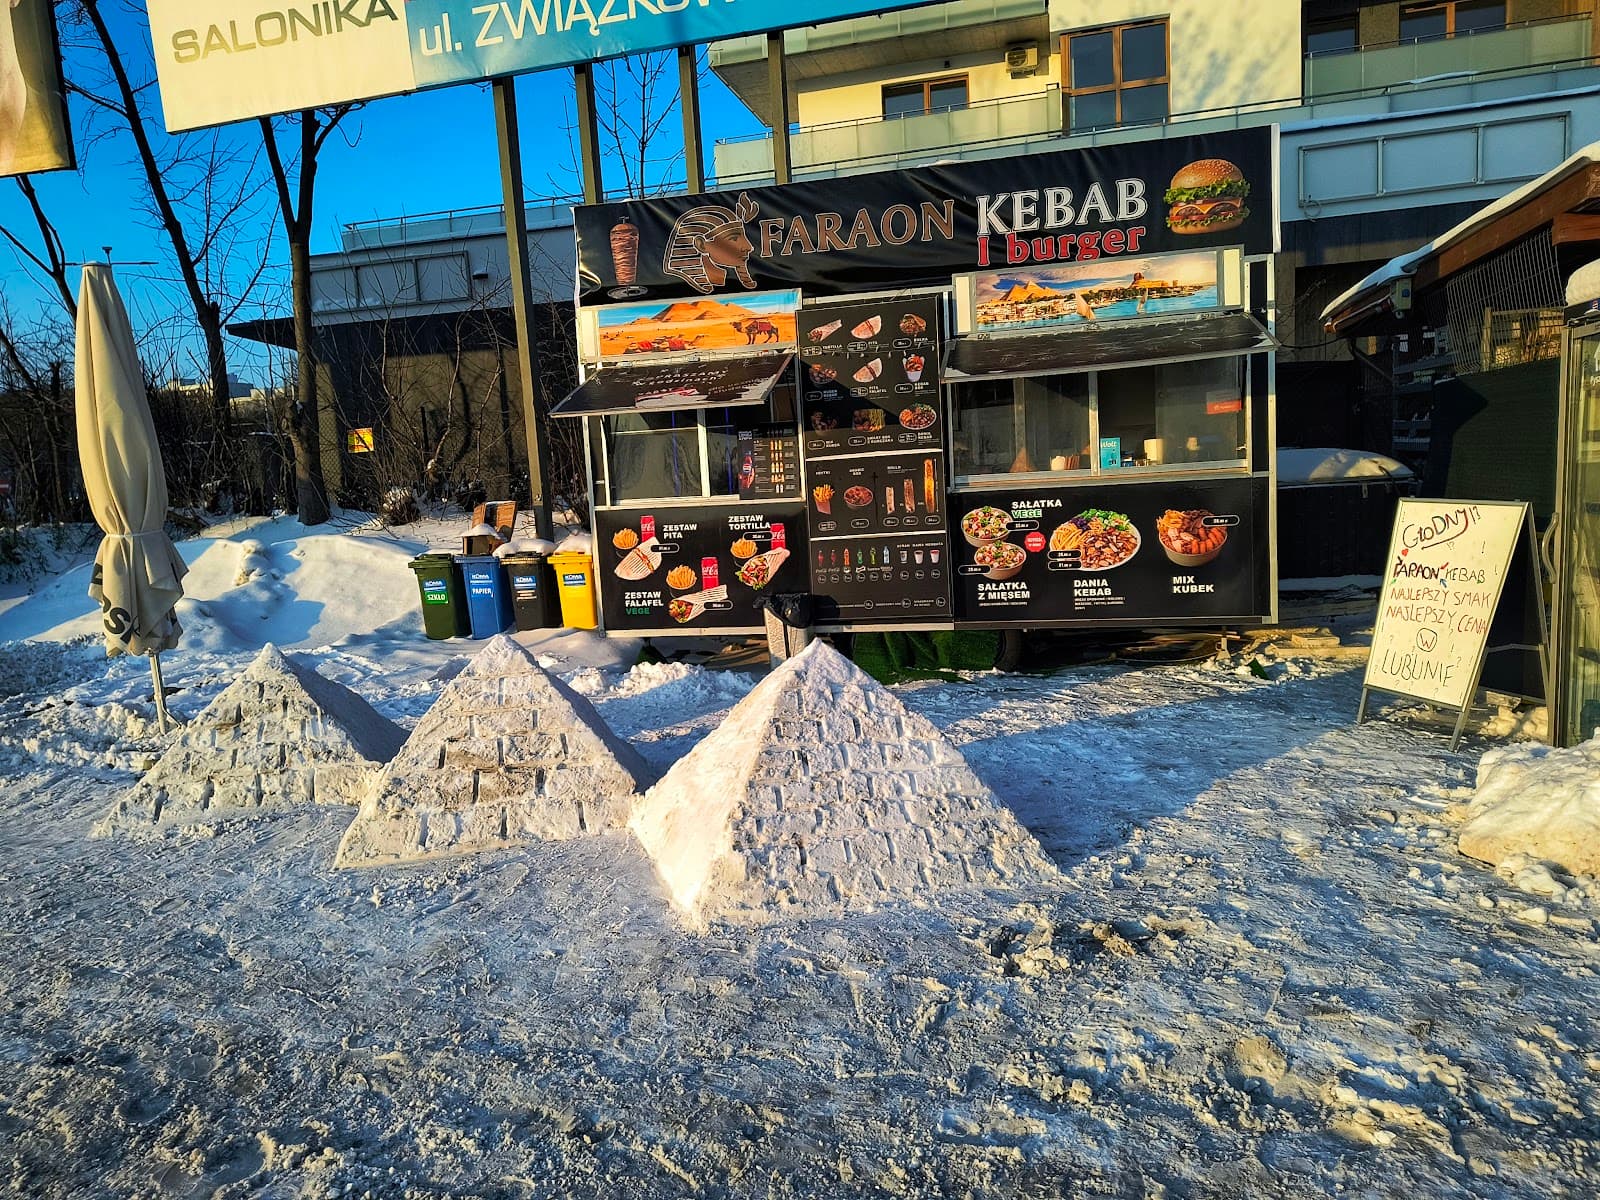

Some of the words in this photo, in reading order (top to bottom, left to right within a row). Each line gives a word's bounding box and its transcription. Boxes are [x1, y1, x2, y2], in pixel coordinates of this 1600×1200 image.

[172, 0, 399, 64] SALONIKA
[419, 13, 463, 57] ul.
[760, 198, 956, 259] FARAON
[975, 177, 1148, 236] KEBAB
[1006, 225, 1146, 265] burger
[1011, 499, 1063, 510] SAŁATKA
[728, 514, 764, 524] ZESTAW
[1012, 509, 1043, 519] VEGE
[662, 523, 698, 533] ZESTAW
[729, 522, 771, 532] TORTILLA
[663, 532, 683, 542] PITA
[1172, 575, 1195, 585] MIX
[1445, 566, 1486, 584] KEBAB
[977, 582, 1028, 592] SAŁATKA
[1073, 578, 1108, 588] DANIA
[472, 587, 493, 595] PAPIER
[1073, 587, 1112, 597] KEBAB
[1172, 584, 1215, 594] KUBEK
[624, 591, 662, 601] ZESTAW
[977, 591, 985, 601] Z
[987, 590, 1031, 601] MIĘSEM
[1390, 587, 1449, 606] NAJLEPSZY
[1453, 591, 1492, 609] SMAK
[625, 599, 664, 608] FALAFEL
[625, 607, 651, 616] VEGE
[1386, 603, 1458, 629] NAJLEPSZY
[1381, 649, 1455, 688] LUBLINIE
